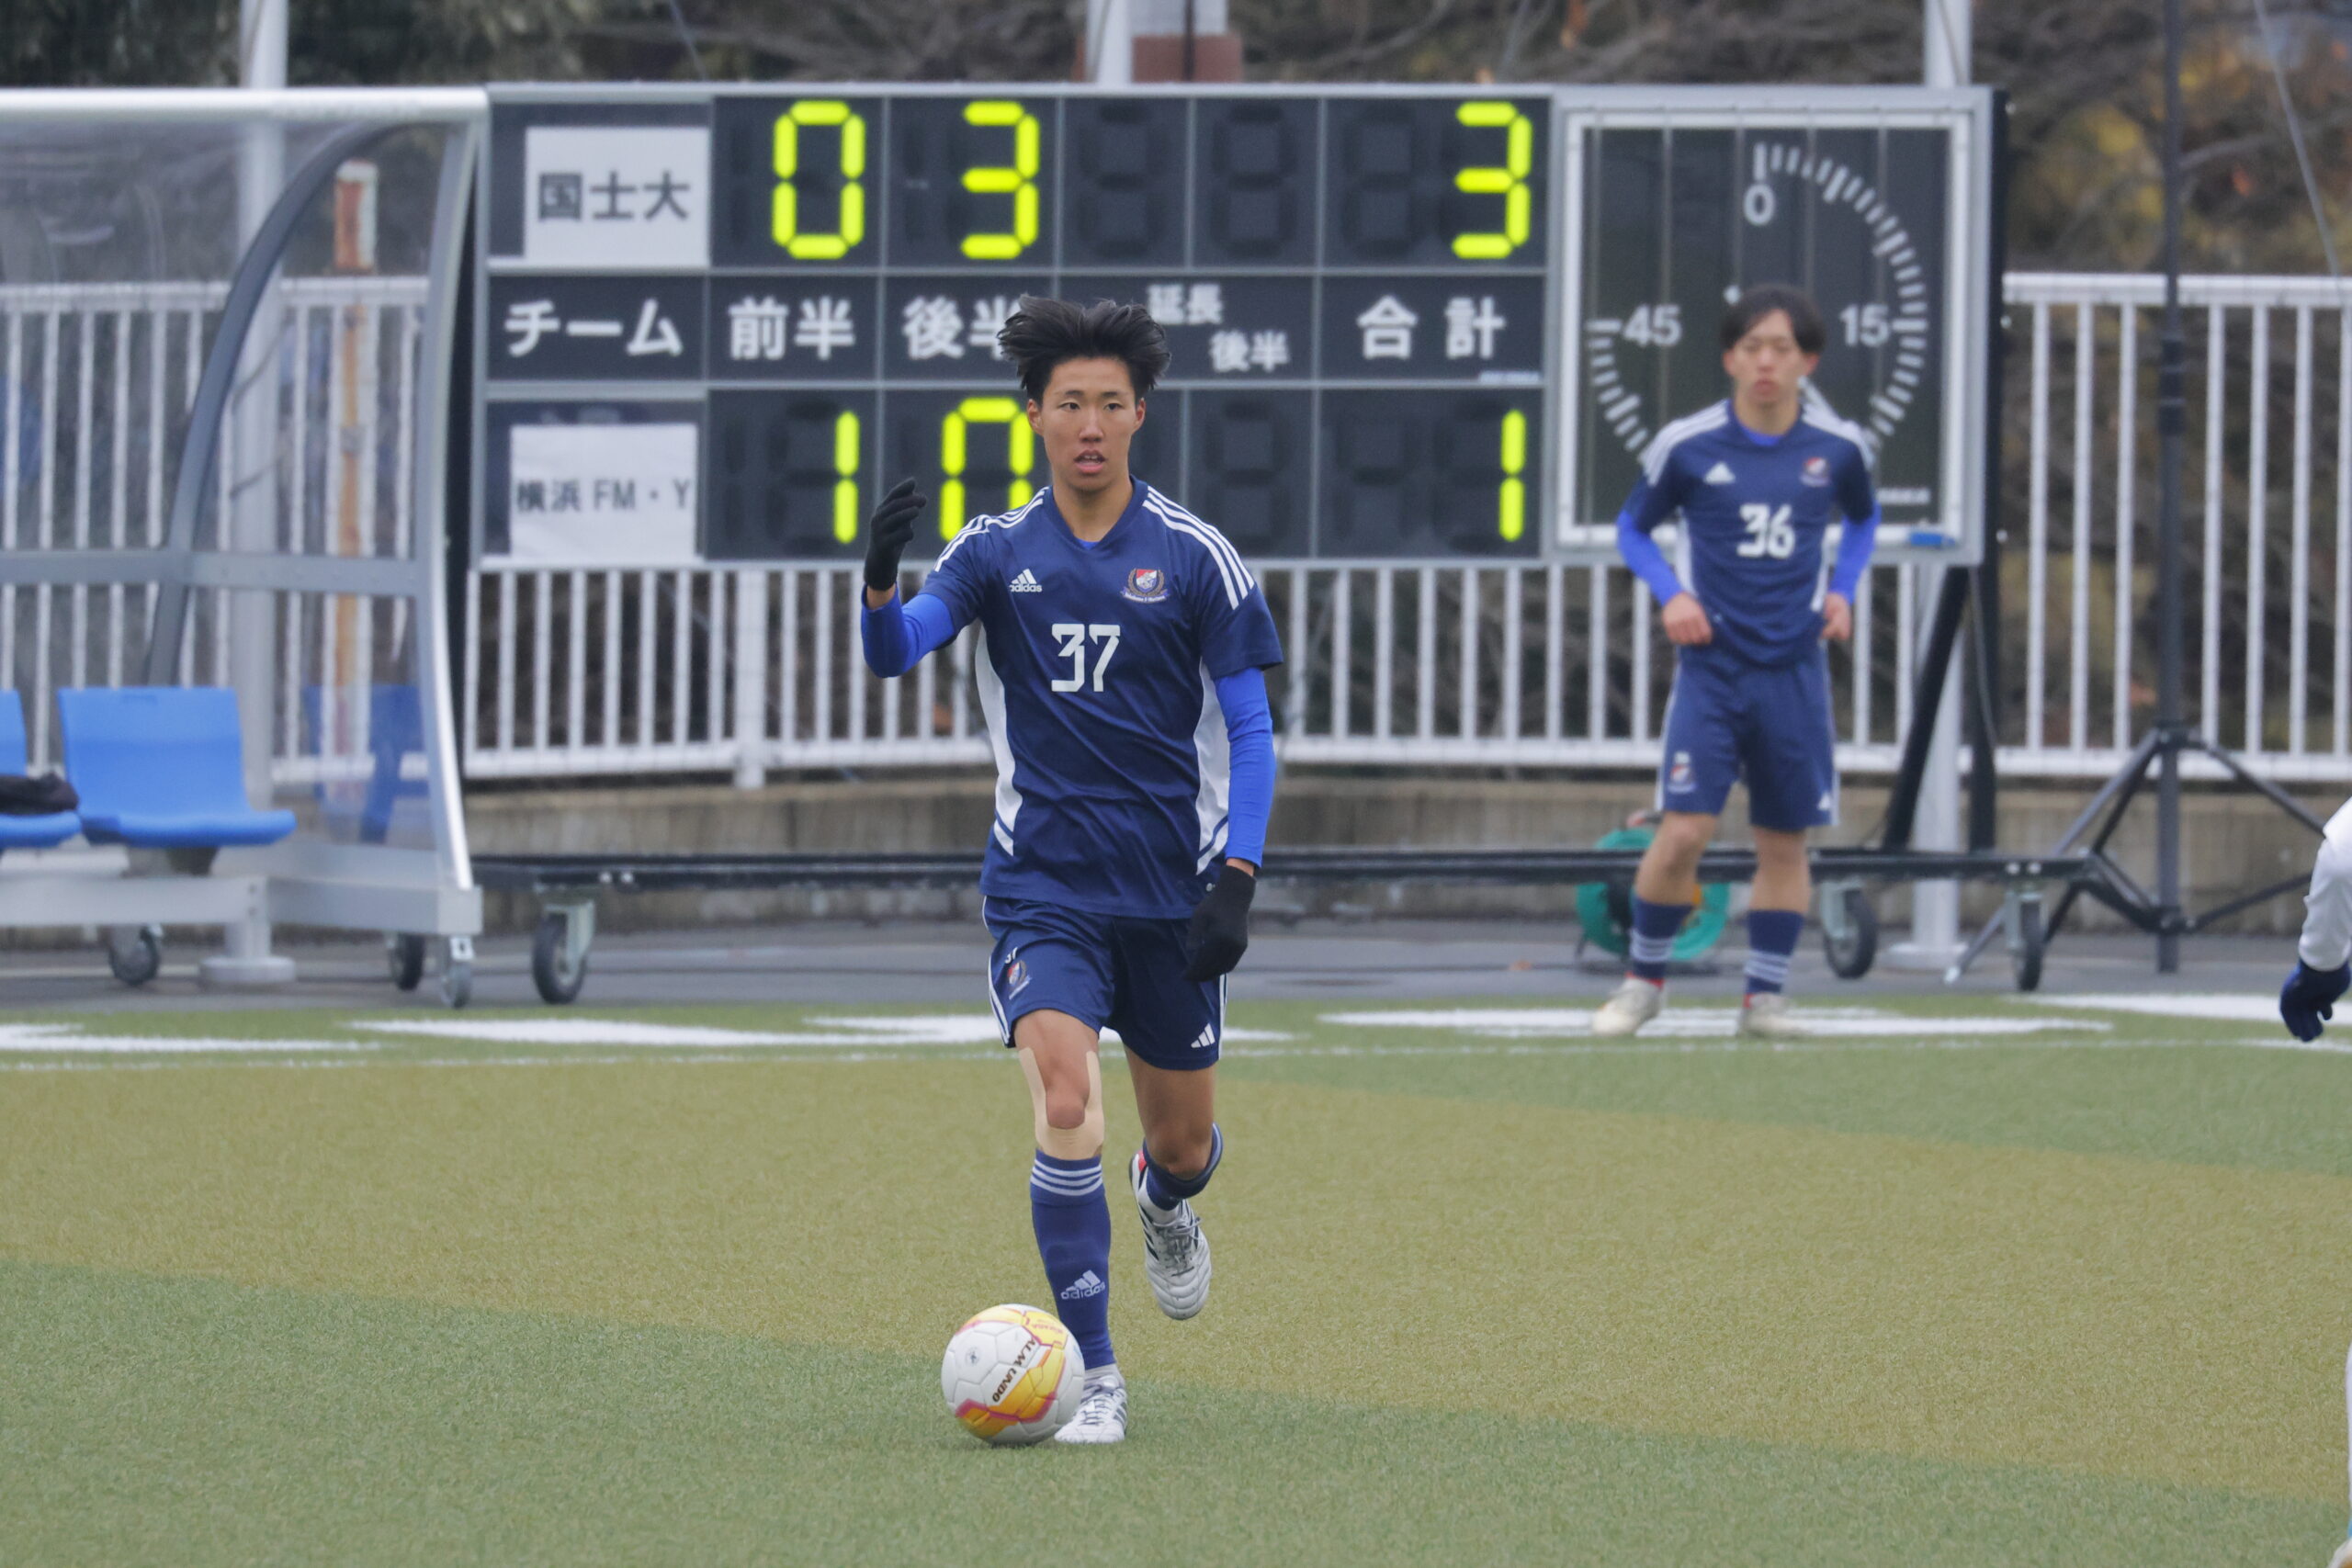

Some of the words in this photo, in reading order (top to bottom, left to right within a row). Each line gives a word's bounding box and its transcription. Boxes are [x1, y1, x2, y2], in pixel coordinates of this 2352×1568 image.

[537, 169, 691, 221] 国士大
[772, 100, 865, 260] 0
[960, 100, 1040, 260] 3
[1452, 101, 1532, 259] 3
[1743, 185, 1775, 226] 0
[504, 299, 684, 357] チーム
[729, 295, 855, 360] 前半
[1621, 304, 1682, 346] 45
[1840, 304, 1892, 346] 15
[833, 411, 861, 544] 1
[1498, 409, 1527, 542] 1
[1736, 502, 1795, 559] 36
[1009, 583, 1043, 592] adidas
[1051, 623, 1121, 693] 37
[1060, 1281, 1105, 1300] adidas
